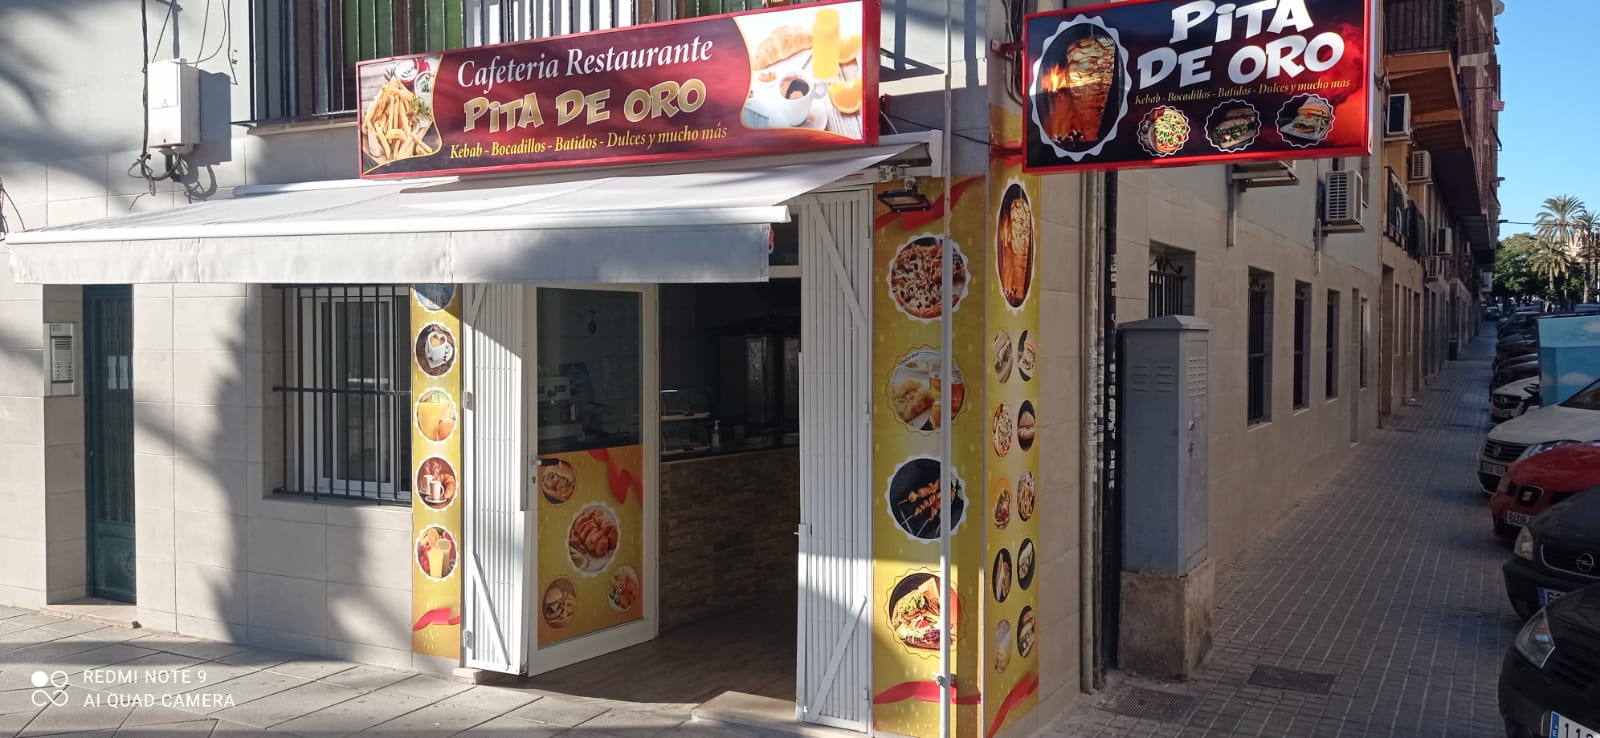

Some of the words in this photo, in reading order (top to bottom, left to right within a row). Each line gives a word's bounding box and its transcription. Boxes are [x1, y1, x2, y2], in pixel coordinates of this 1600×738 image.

[457, 53, 559, 94] Cafeteria
[565, 35, 713, 76] Restaurante
[1137, 45, 1213, 89] DE
[1228, 31, 1345, 84] ORO
[555, 89, 611, 126] DE
[623, 78, 707, 122] ORO
[1134, 92, 1161, 105] Kebab
[1167, 88, 1211, 102] Bocadillos
[1217, 85, 1251, 98] Batidos
[1258, 82, 1288, 95] Dulces
[1289, 84, 1296, 95] y
[1297, 79, 1328, 92] mucho
[449, 142, 483, 159] Kebab
[491, 138, 546, 156] Bocadillos
[554, 134, 598, 152] Batidos
[606, 130, 646, 148] Dulces
[646, 134, 656, 150] y
[658, 125, 699, 143] mucho
[701, 122, 728, 140] más
